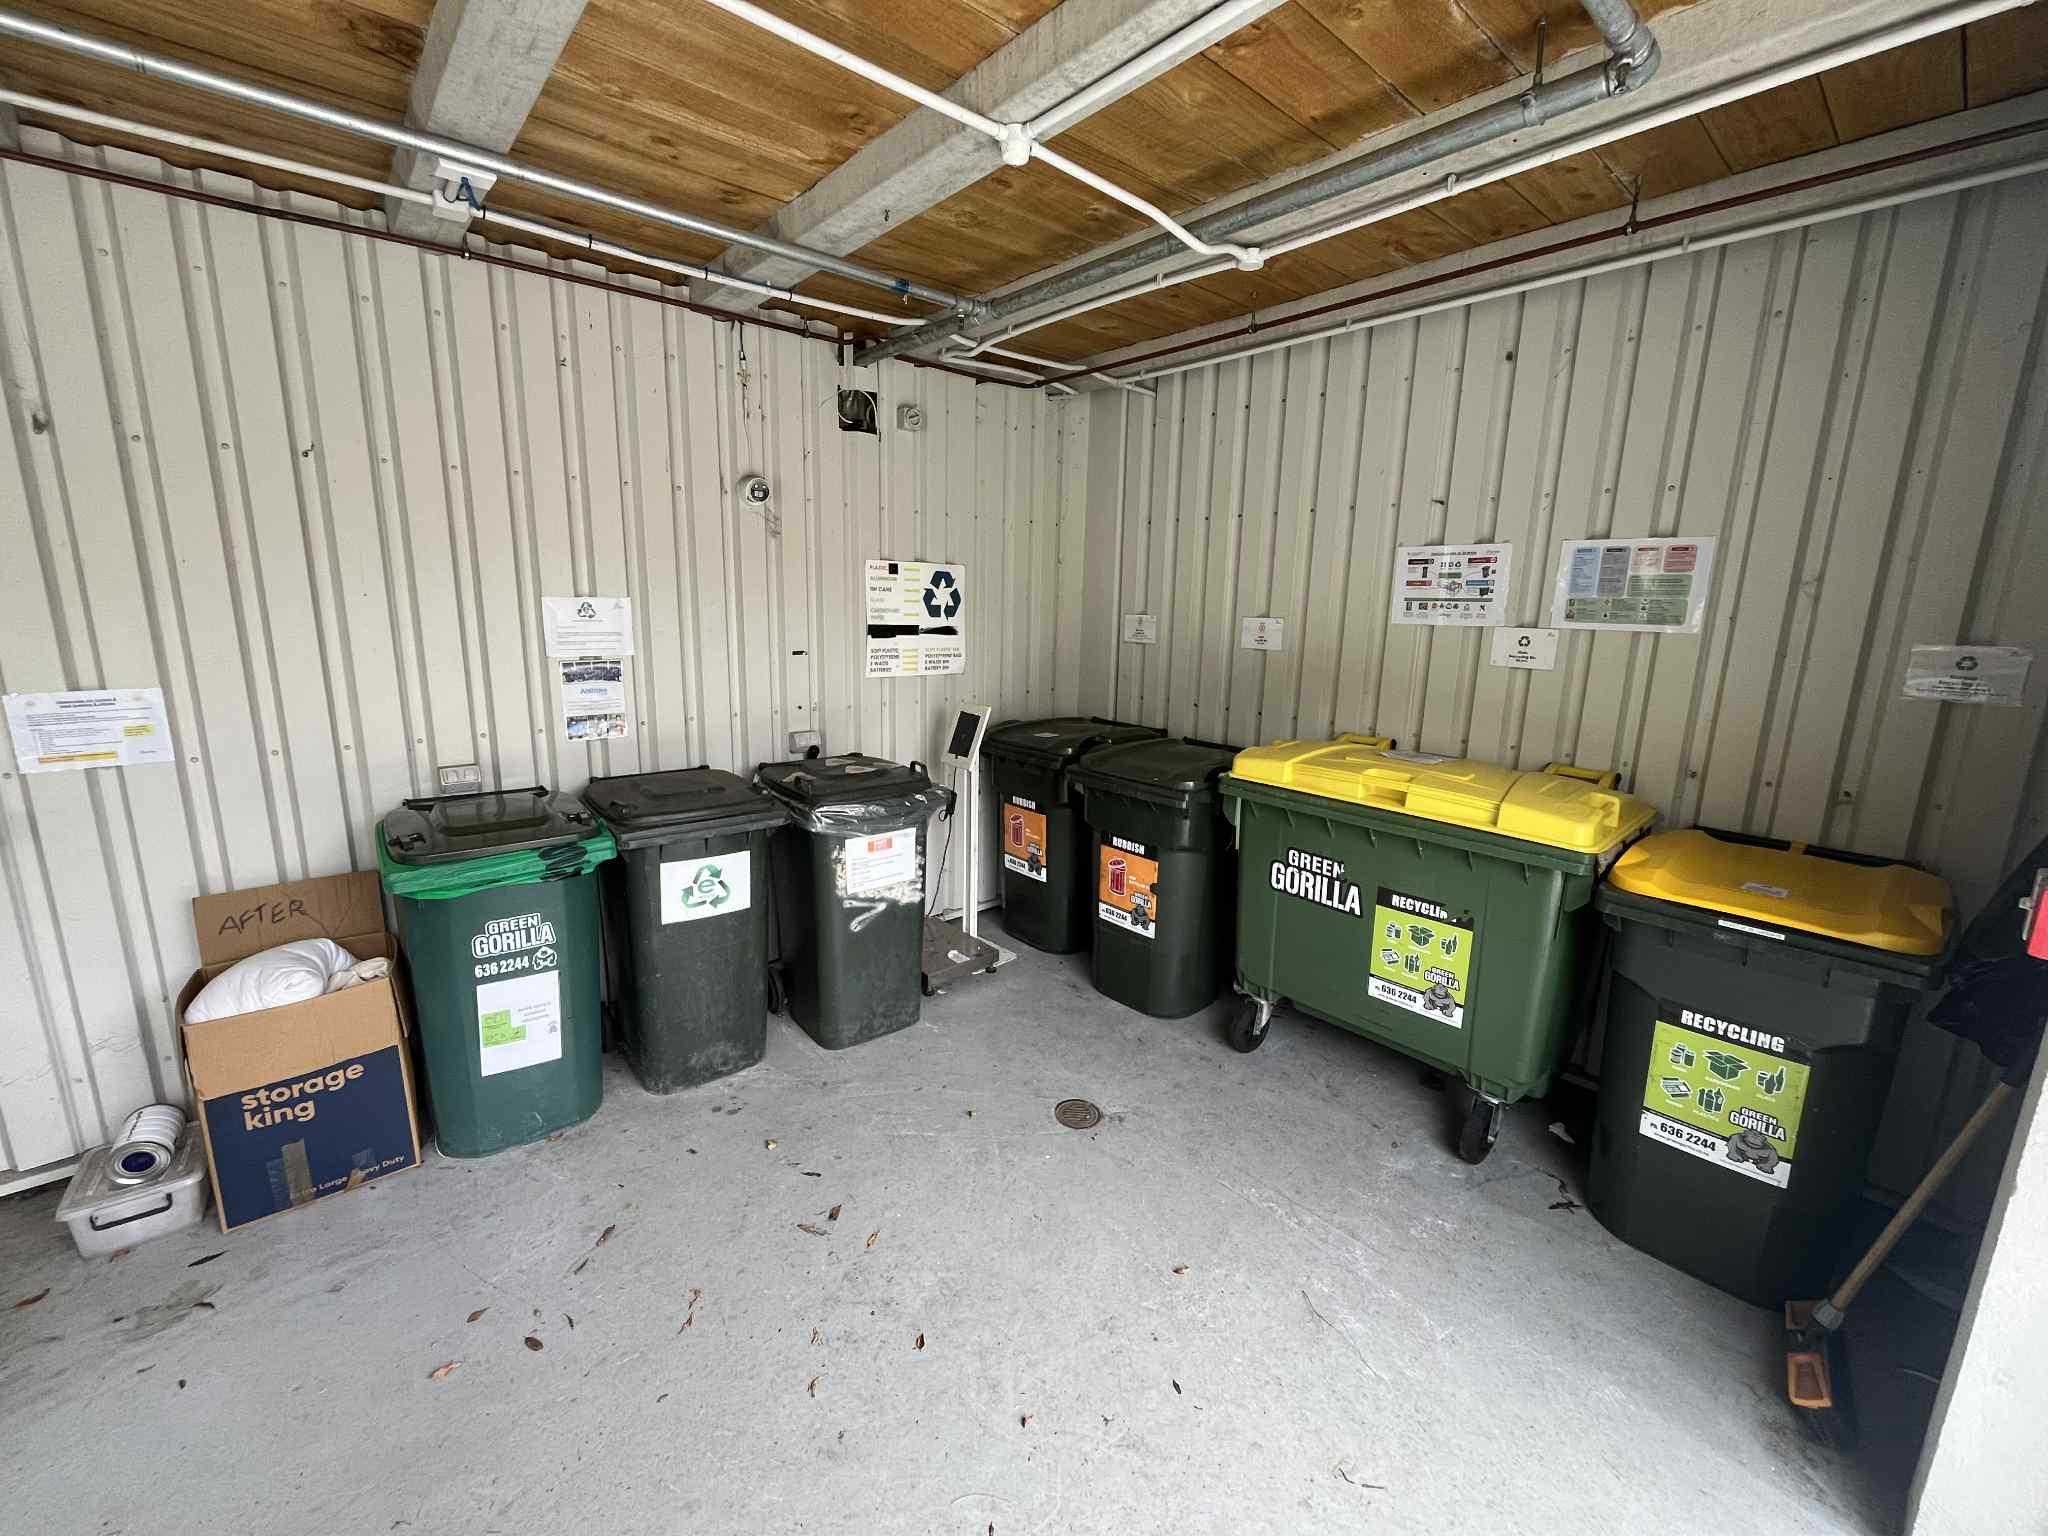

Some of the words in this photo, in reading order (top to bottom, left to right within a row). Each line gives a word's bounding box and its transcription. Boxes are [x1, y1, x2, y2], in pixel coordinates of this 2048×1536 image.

[1288, 849, 1344, 878] GREEN
[1271, 862, 1361, 916] GORILLA
[218, 899, 307, 936] AFTER
[488, 915, 538, 935] GREEN
[474, 924, 553, 957] GORILLA
[475, 961, 498, 978] 636
[499, 955, 530, 973] 2244
[1381, 984, 1396, 996] 636
[1397, 990, 1417, 1004] 2244
[1681, 1009, 1785, 1053] RECYCLING
[241, 1063, 365, 1111] storage
[244, 1100, 316, 1132] king
[1730, 1111, 1785, 1141] GORILLA
[1741, 1107, 1777, 1126] GREEN
[1660, 1122, 1684, 1139] 636
[1686, 1132, 1716, 1152] 2244
[382, 1155, 405, 1168] Duty
